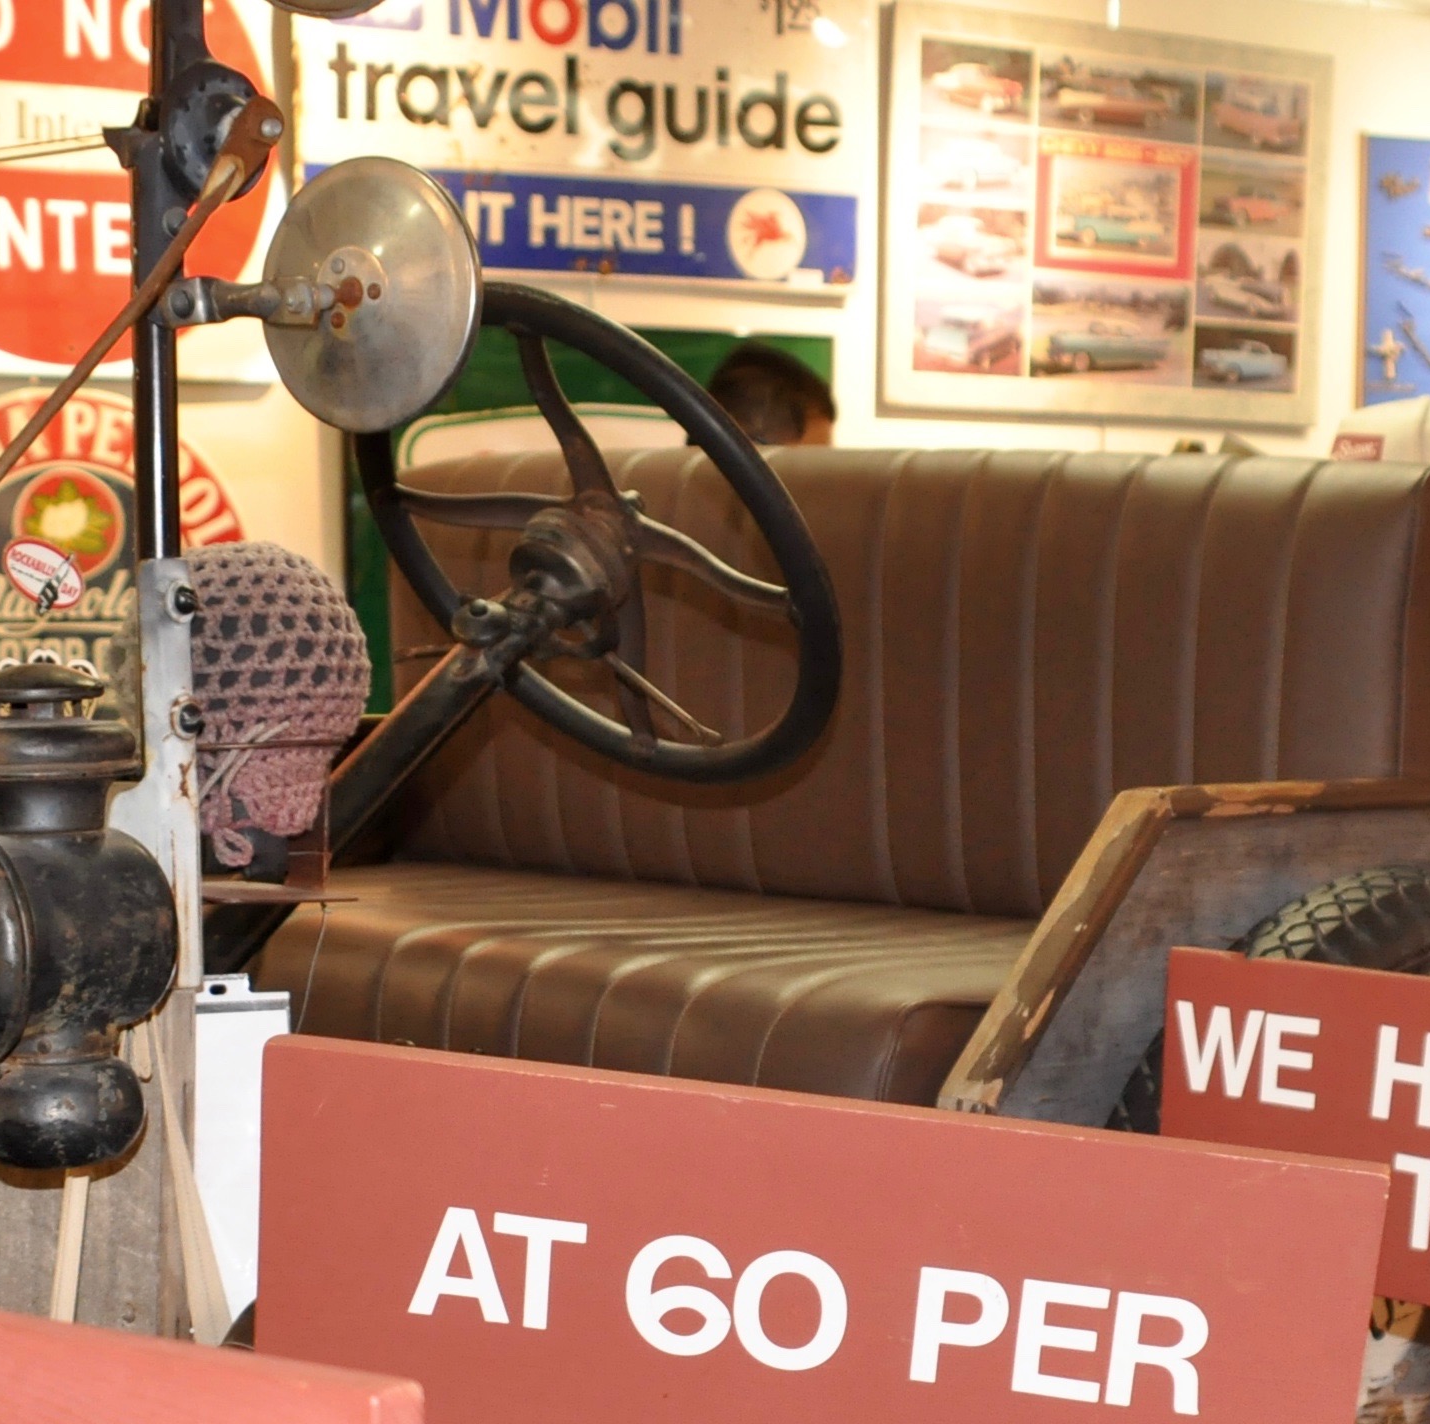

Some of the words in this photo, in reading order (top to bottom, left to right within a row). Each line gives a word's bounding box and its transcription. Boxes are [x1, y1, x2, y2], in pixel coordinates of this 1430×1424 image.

[63, 0, 152, 64] NO
[328, 41, 579, 135] travel
[606, 67, 842, 162] guide
[528, 194, 665, 254] HERE
[1175, 999, 1322, 1111] WE
[407, 1205, 588, 1331] AT
[624, 1234, 849, 1372] 60
[908, 1265, 1211, 1416] PER
